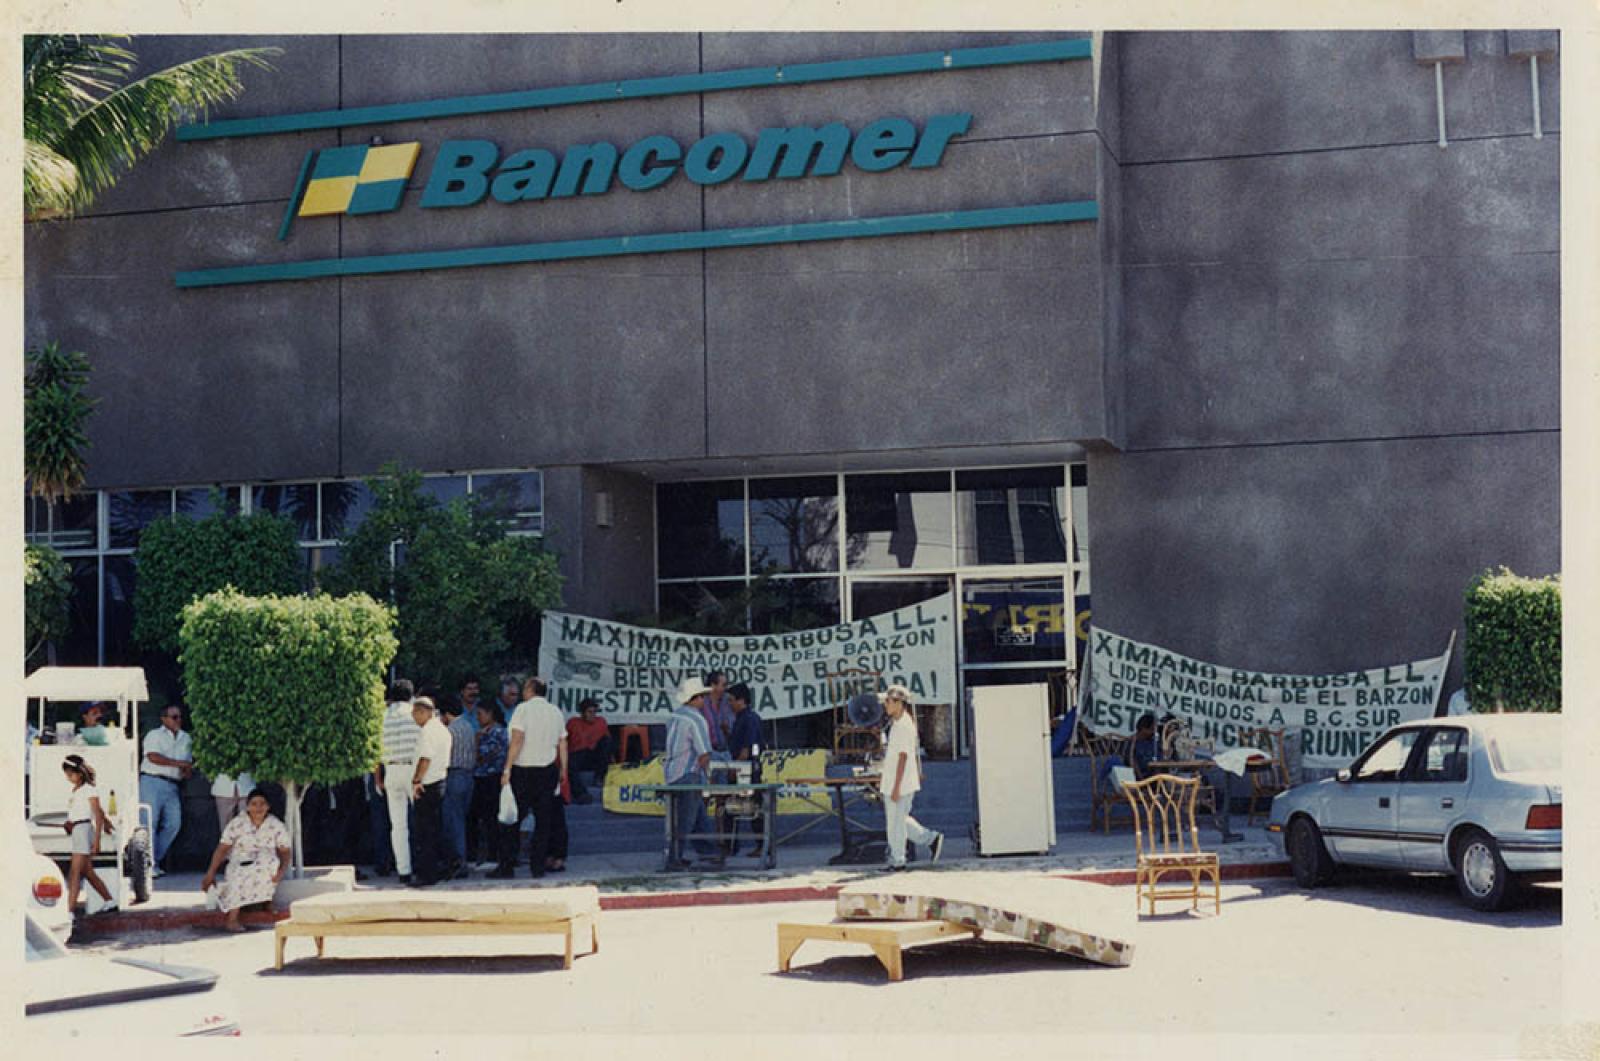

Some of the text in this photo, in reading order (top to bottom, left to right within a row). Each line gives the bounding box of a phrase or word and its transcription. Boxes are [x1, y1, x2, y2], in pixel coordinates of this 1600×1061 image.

[420, 112, 972, 207] Bancomer
[561, 616, 730, 652] MAXIMIANO
[893, 605, 948, 631] LL.
[613, 628, 935, 667] LIDER NACIONAL DEL BARZON
[614, 665, 775, 689] BIENVEDOS.
[782, 664, 798, 682] A
[1108, 661, 1433, 706] LIDER NACIONAL DE EL BARZON
[1232, 670, 1370, 689] BARBOSA
[1383, 664, 1440, 685] LL.
[1269, 708, 1285, 725] A
